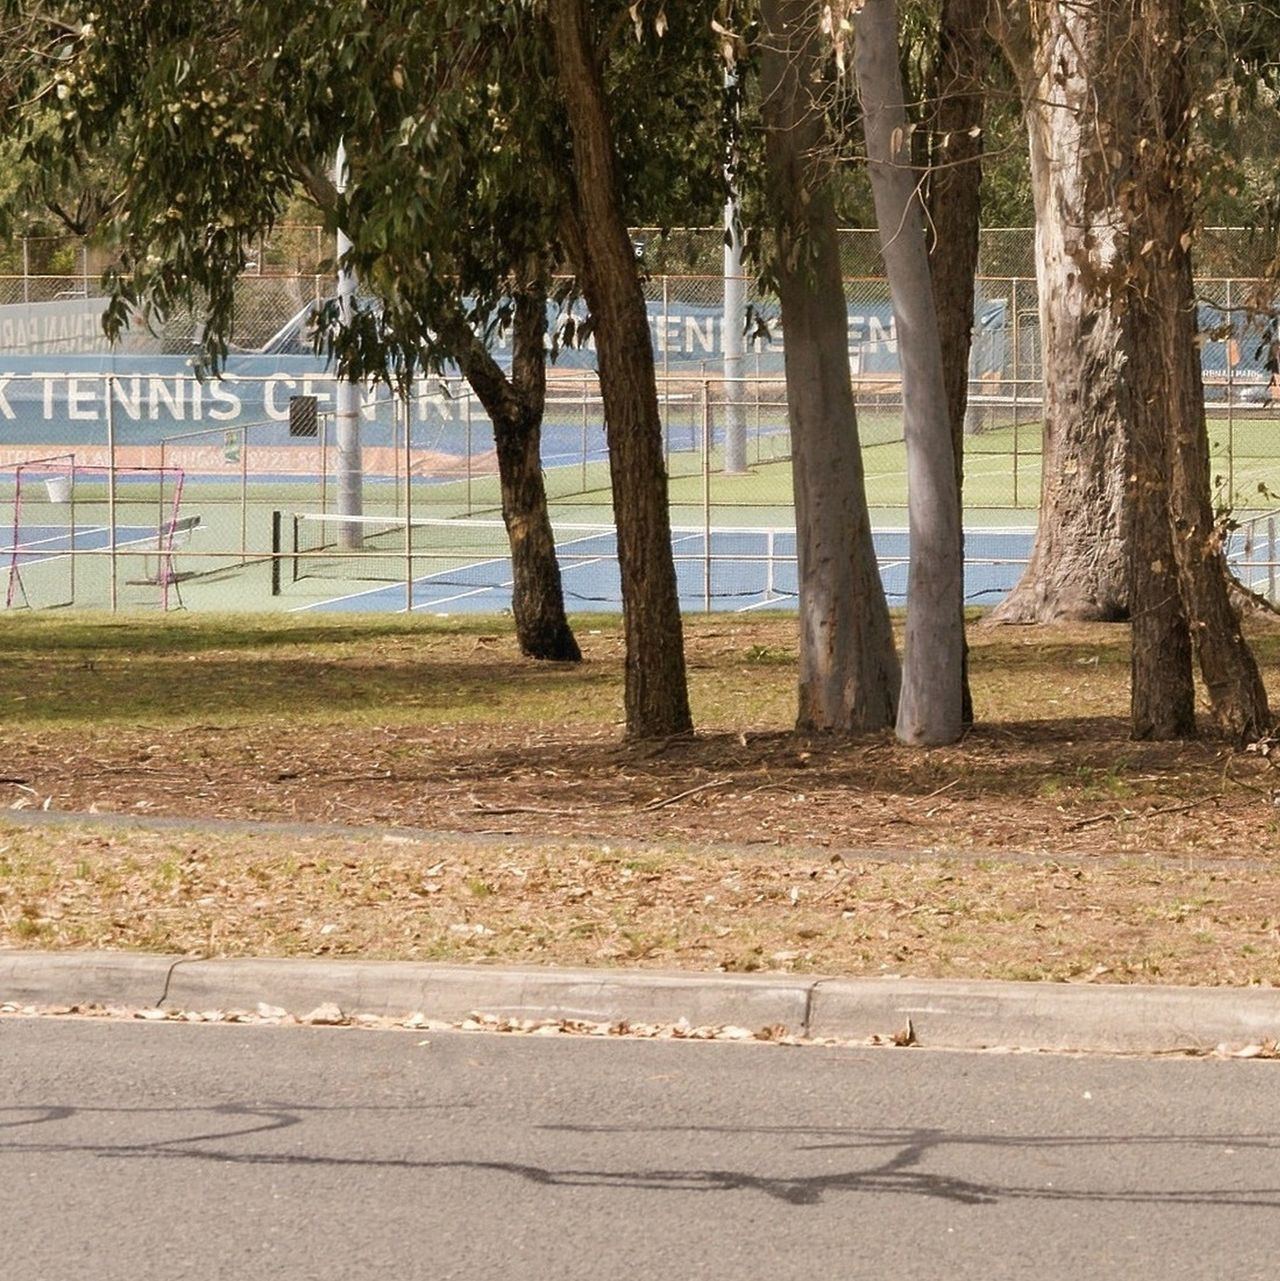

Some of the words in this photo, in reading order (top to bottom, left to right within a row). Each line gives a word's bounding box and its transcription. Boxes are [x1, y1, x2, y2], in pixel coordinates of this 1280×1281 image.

[647, 315, 784, 353] ENIS
[32, 372, 242, 420] TENNIS
[264, 373, 493, 420] CERE
